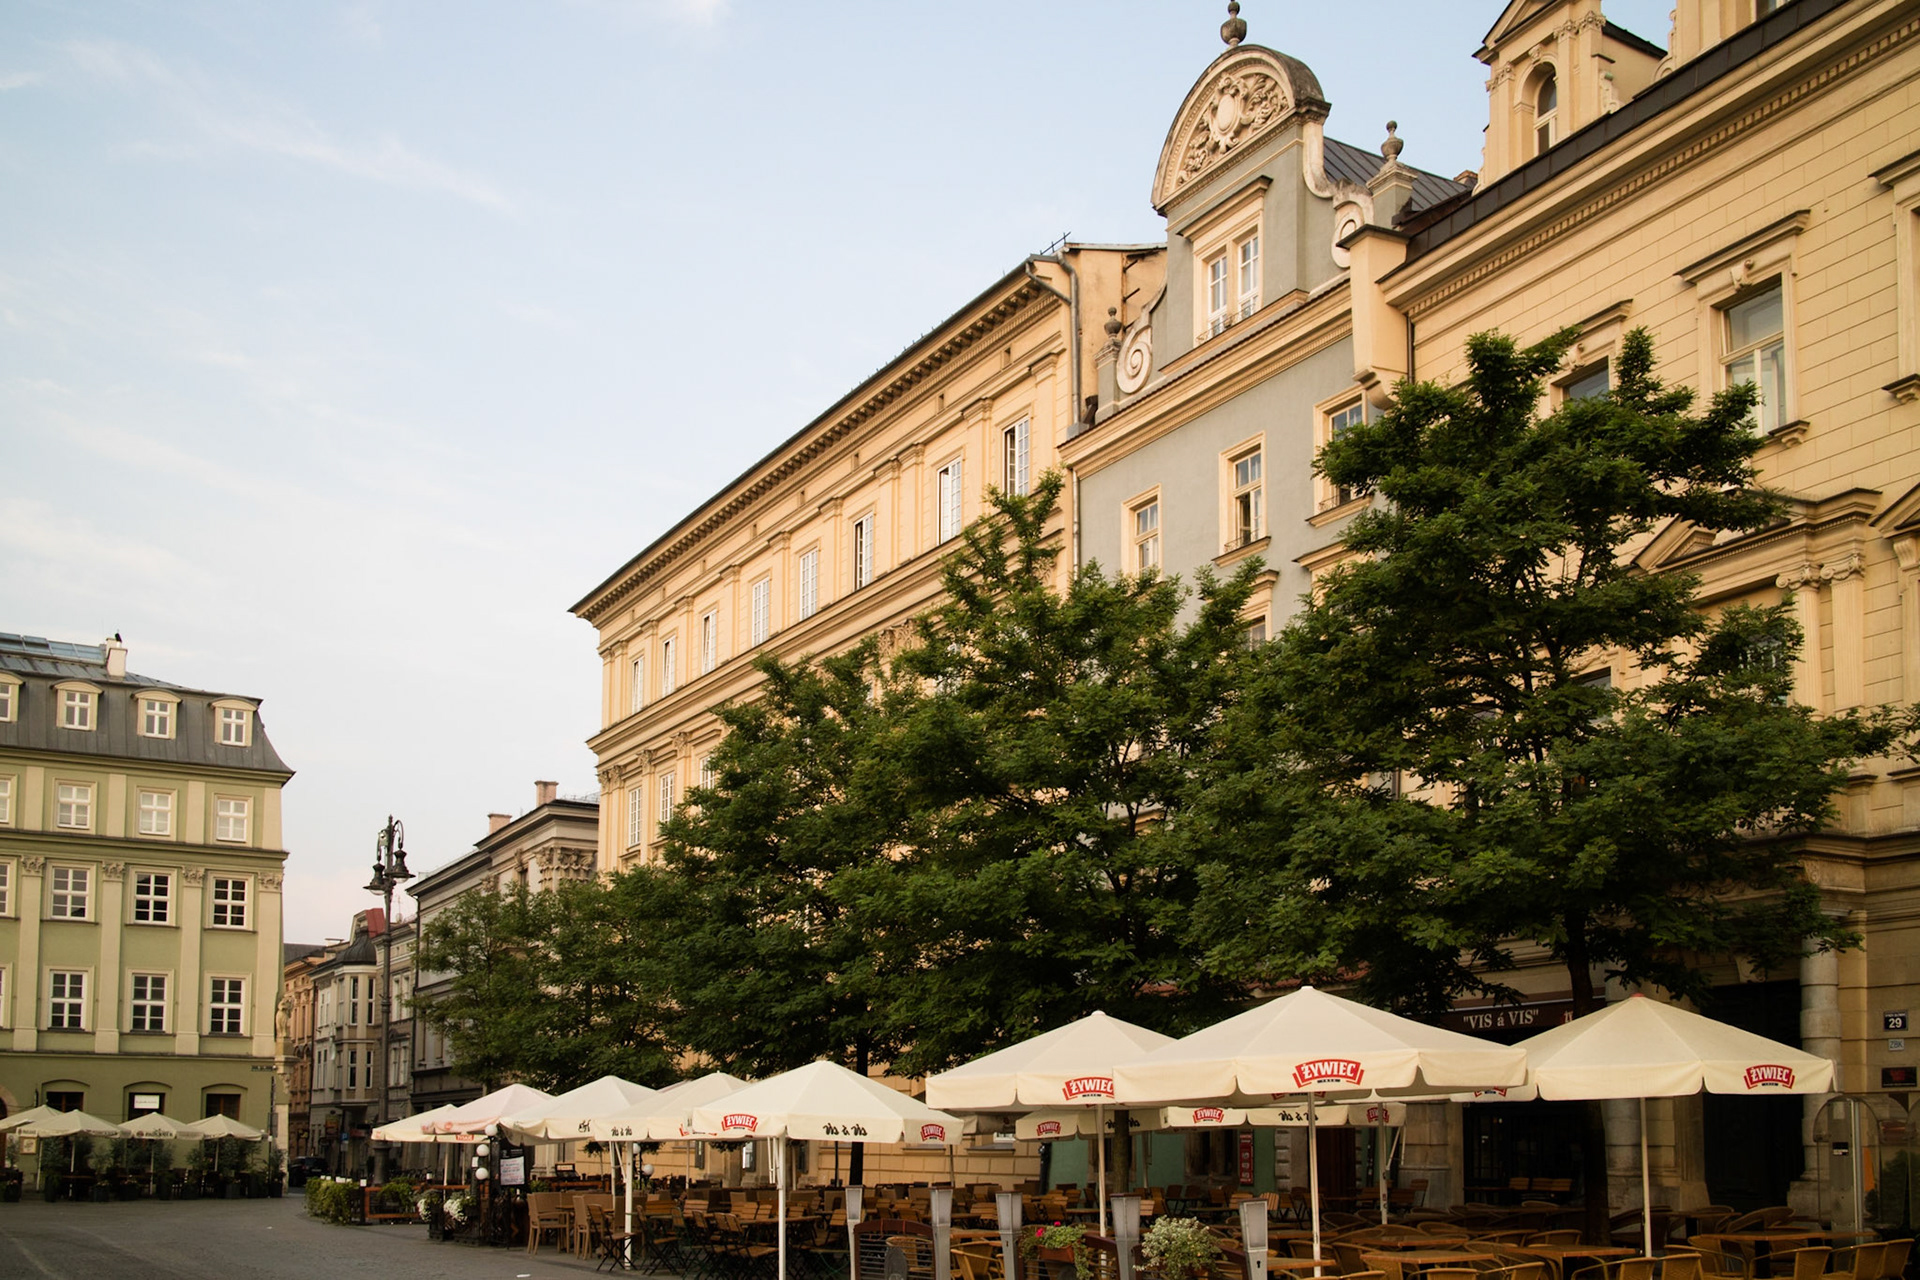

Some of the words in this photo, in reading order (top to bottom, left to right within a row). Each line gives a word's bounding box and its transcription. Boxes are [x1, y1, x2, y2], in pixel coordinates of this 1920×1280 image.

[1888, 1017, 1902, 1029] 29
[1301, 1061, 1356, 1079] ŻYWIEC
[1750, 1067, 1789, 1082] ŻYWIEC
[1069, 1079, 1113, 1093] ŻYWIEC
[725, 1115, 756, 1127] ŻYWIEC
